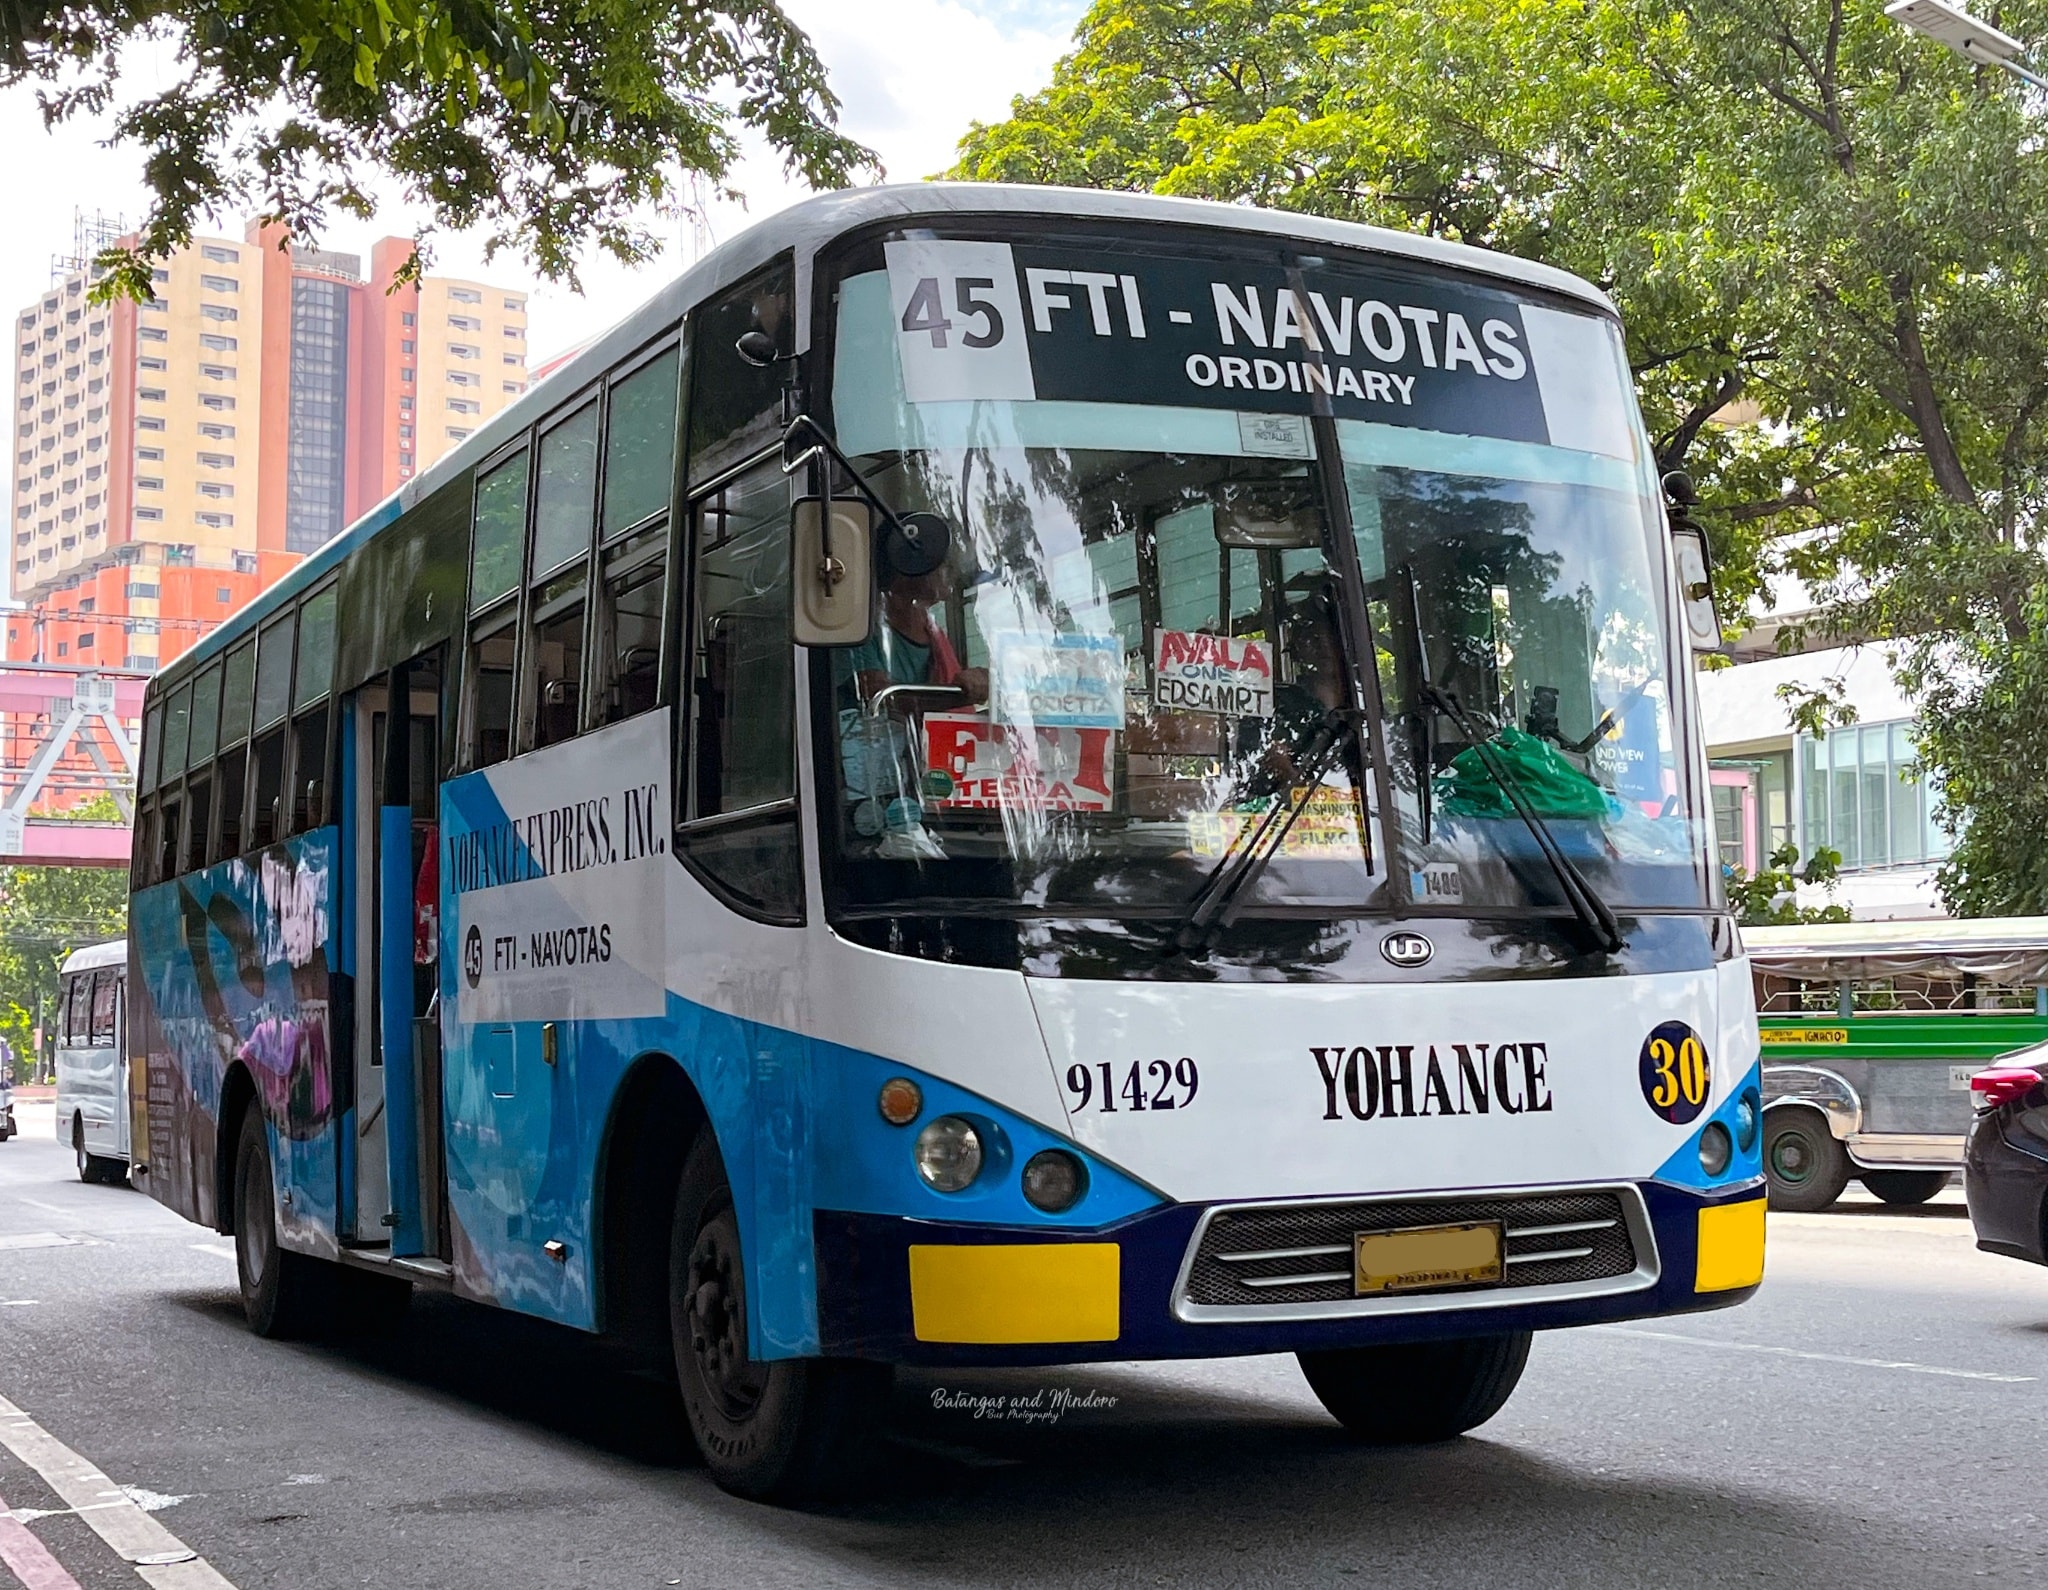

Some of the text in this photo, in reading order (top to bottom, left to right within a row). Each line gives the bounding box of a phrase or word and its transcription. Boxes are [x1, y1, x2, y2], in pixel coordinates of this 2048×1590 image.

[902, 277, 1005, 349] 45
[1025, 266, 1148, 339] FTI
[1211, 283, 1528, 381] NAVOTAS
[1186, 353, 1418, 406] ORDINARY
[1158, 631, 1270, 678] AYALA
[1181, 664, 1233, 683] ONE
[449, 819, 523, 895] YOHANCE
[623, 783, 665, 862] INC.
[465, 939, 482, 976] 45
[494, 936, 517, 972] FTI
[531, 923, 612, 969] NAVOTAS
[1388, 938, 1430, 959] UD
[1066, 1037, 1706, 1121] 91429 YOHANCE 30
